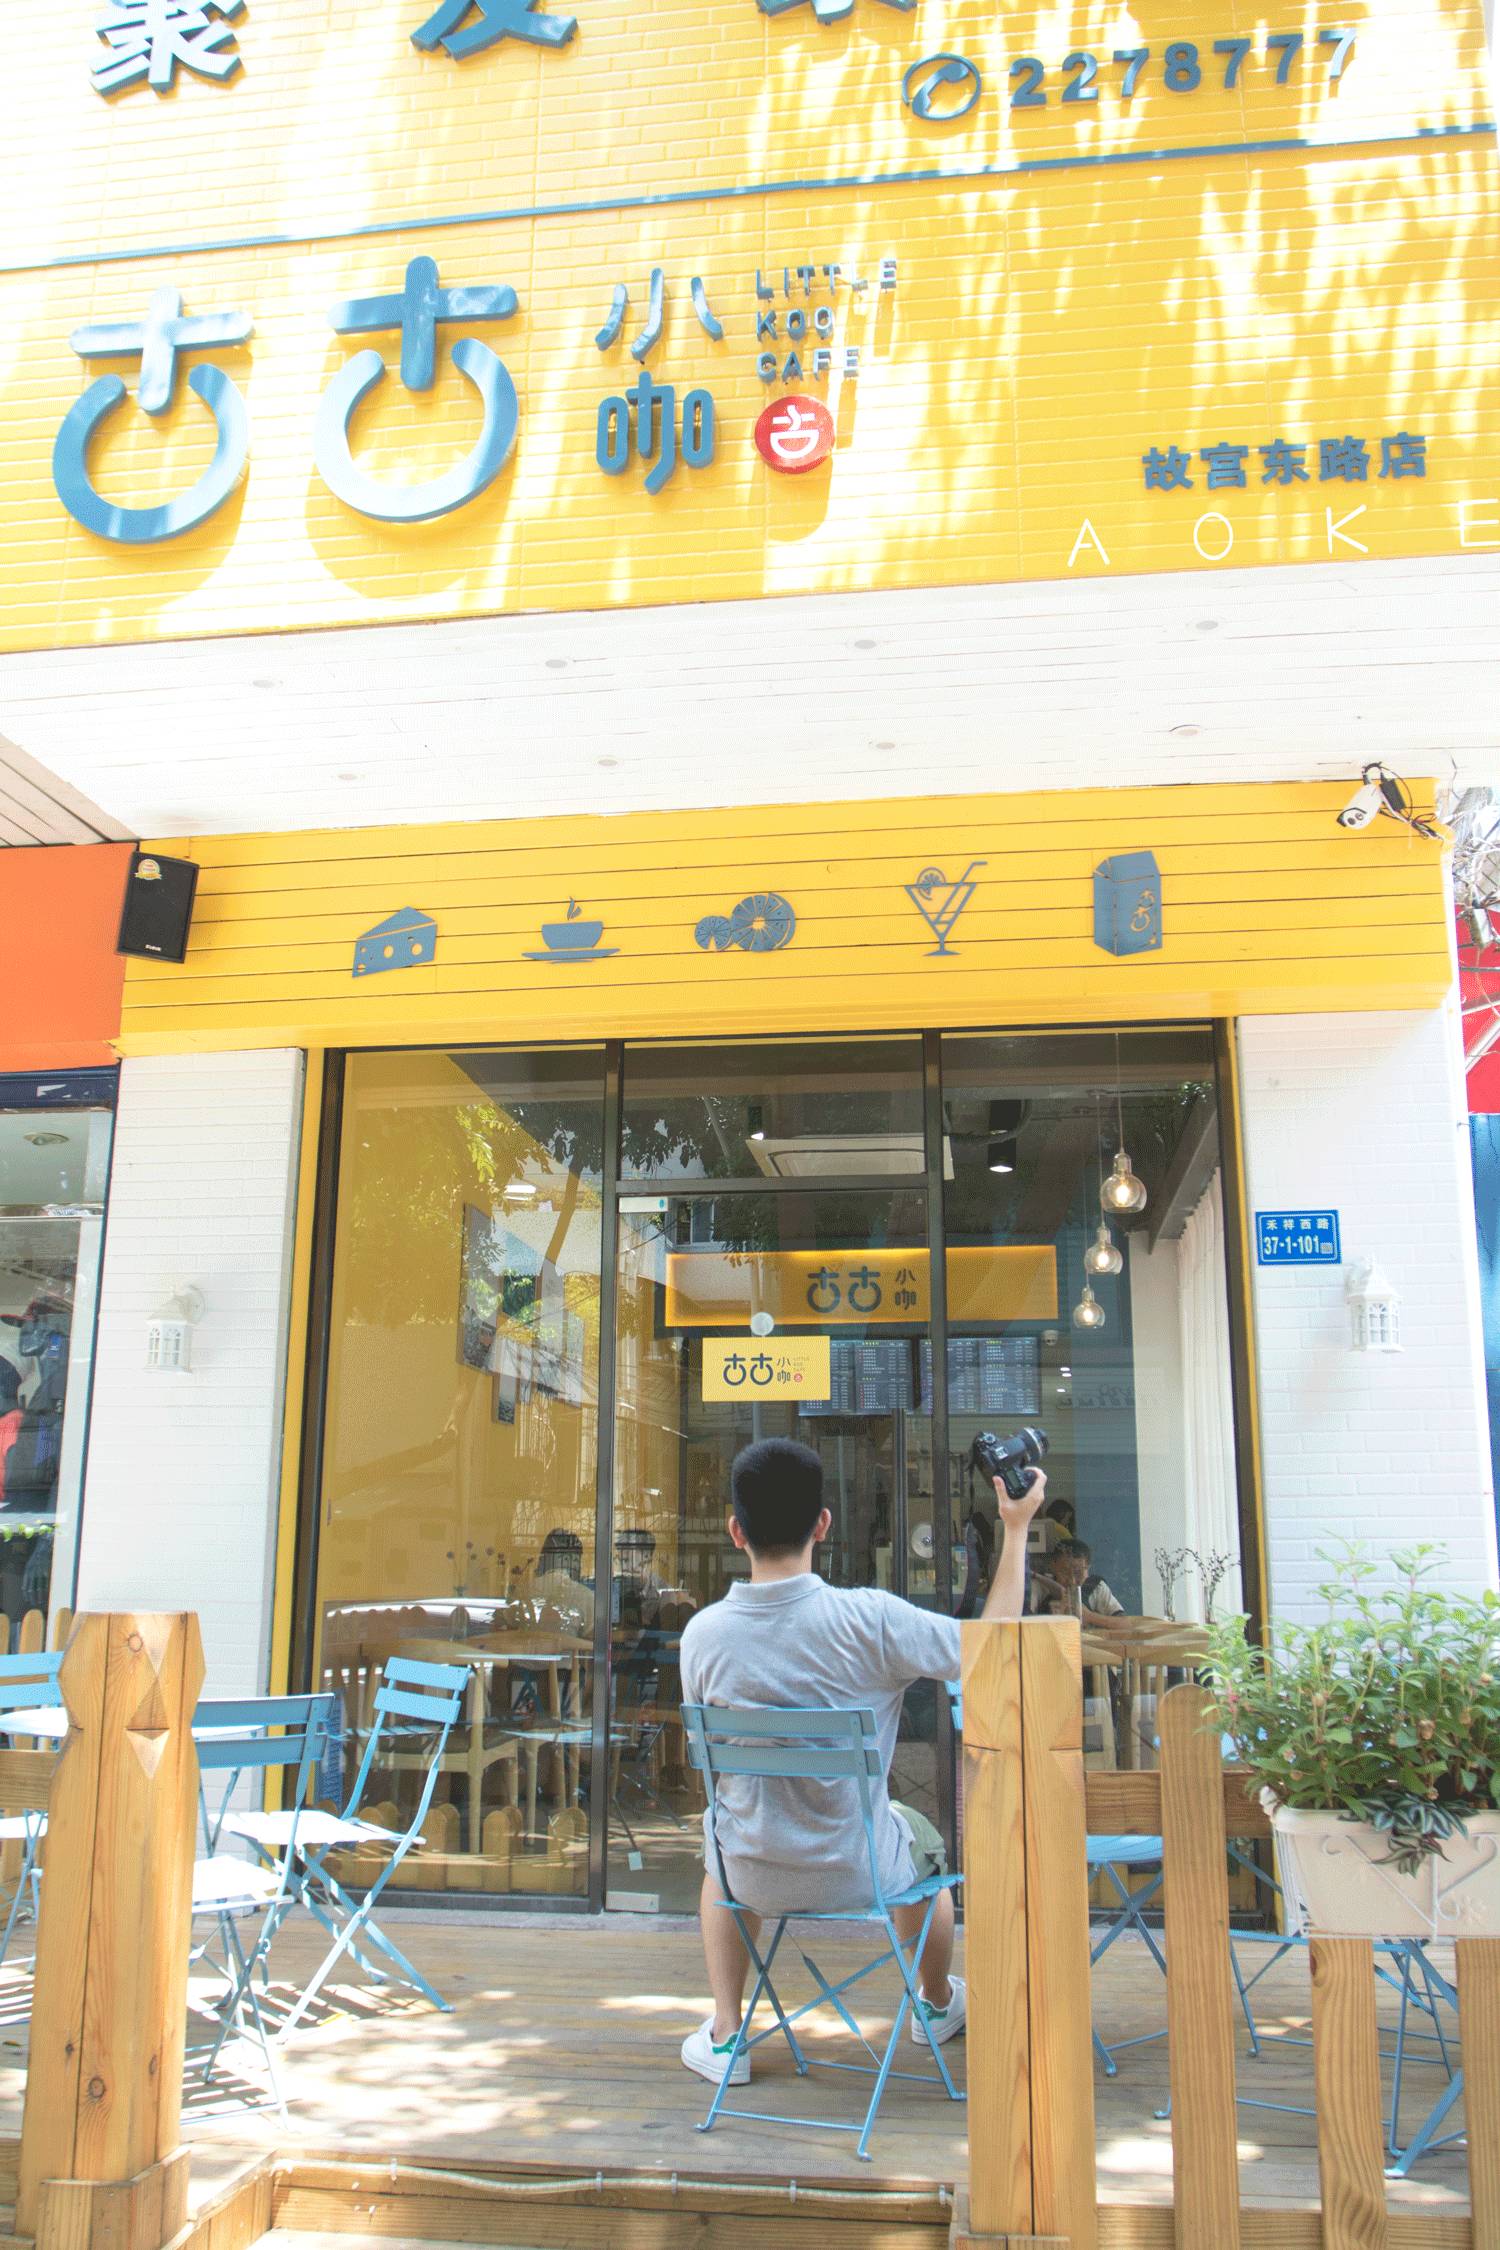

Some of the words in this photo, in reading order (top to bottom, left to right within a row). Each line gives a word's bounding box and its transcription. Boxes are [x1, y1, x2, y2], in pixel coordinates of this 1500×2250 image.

[1008, 27, 1357, 109] 2278777
[755, 258, 897, 301] LITTLE
[756, 306, 834, 342] KOO
[756, 348, 860, 385] CAFE
[1141, 431, 1428, 492] 故宫东路店
[1263, 1234, 1320, 1255] 37-1-101
